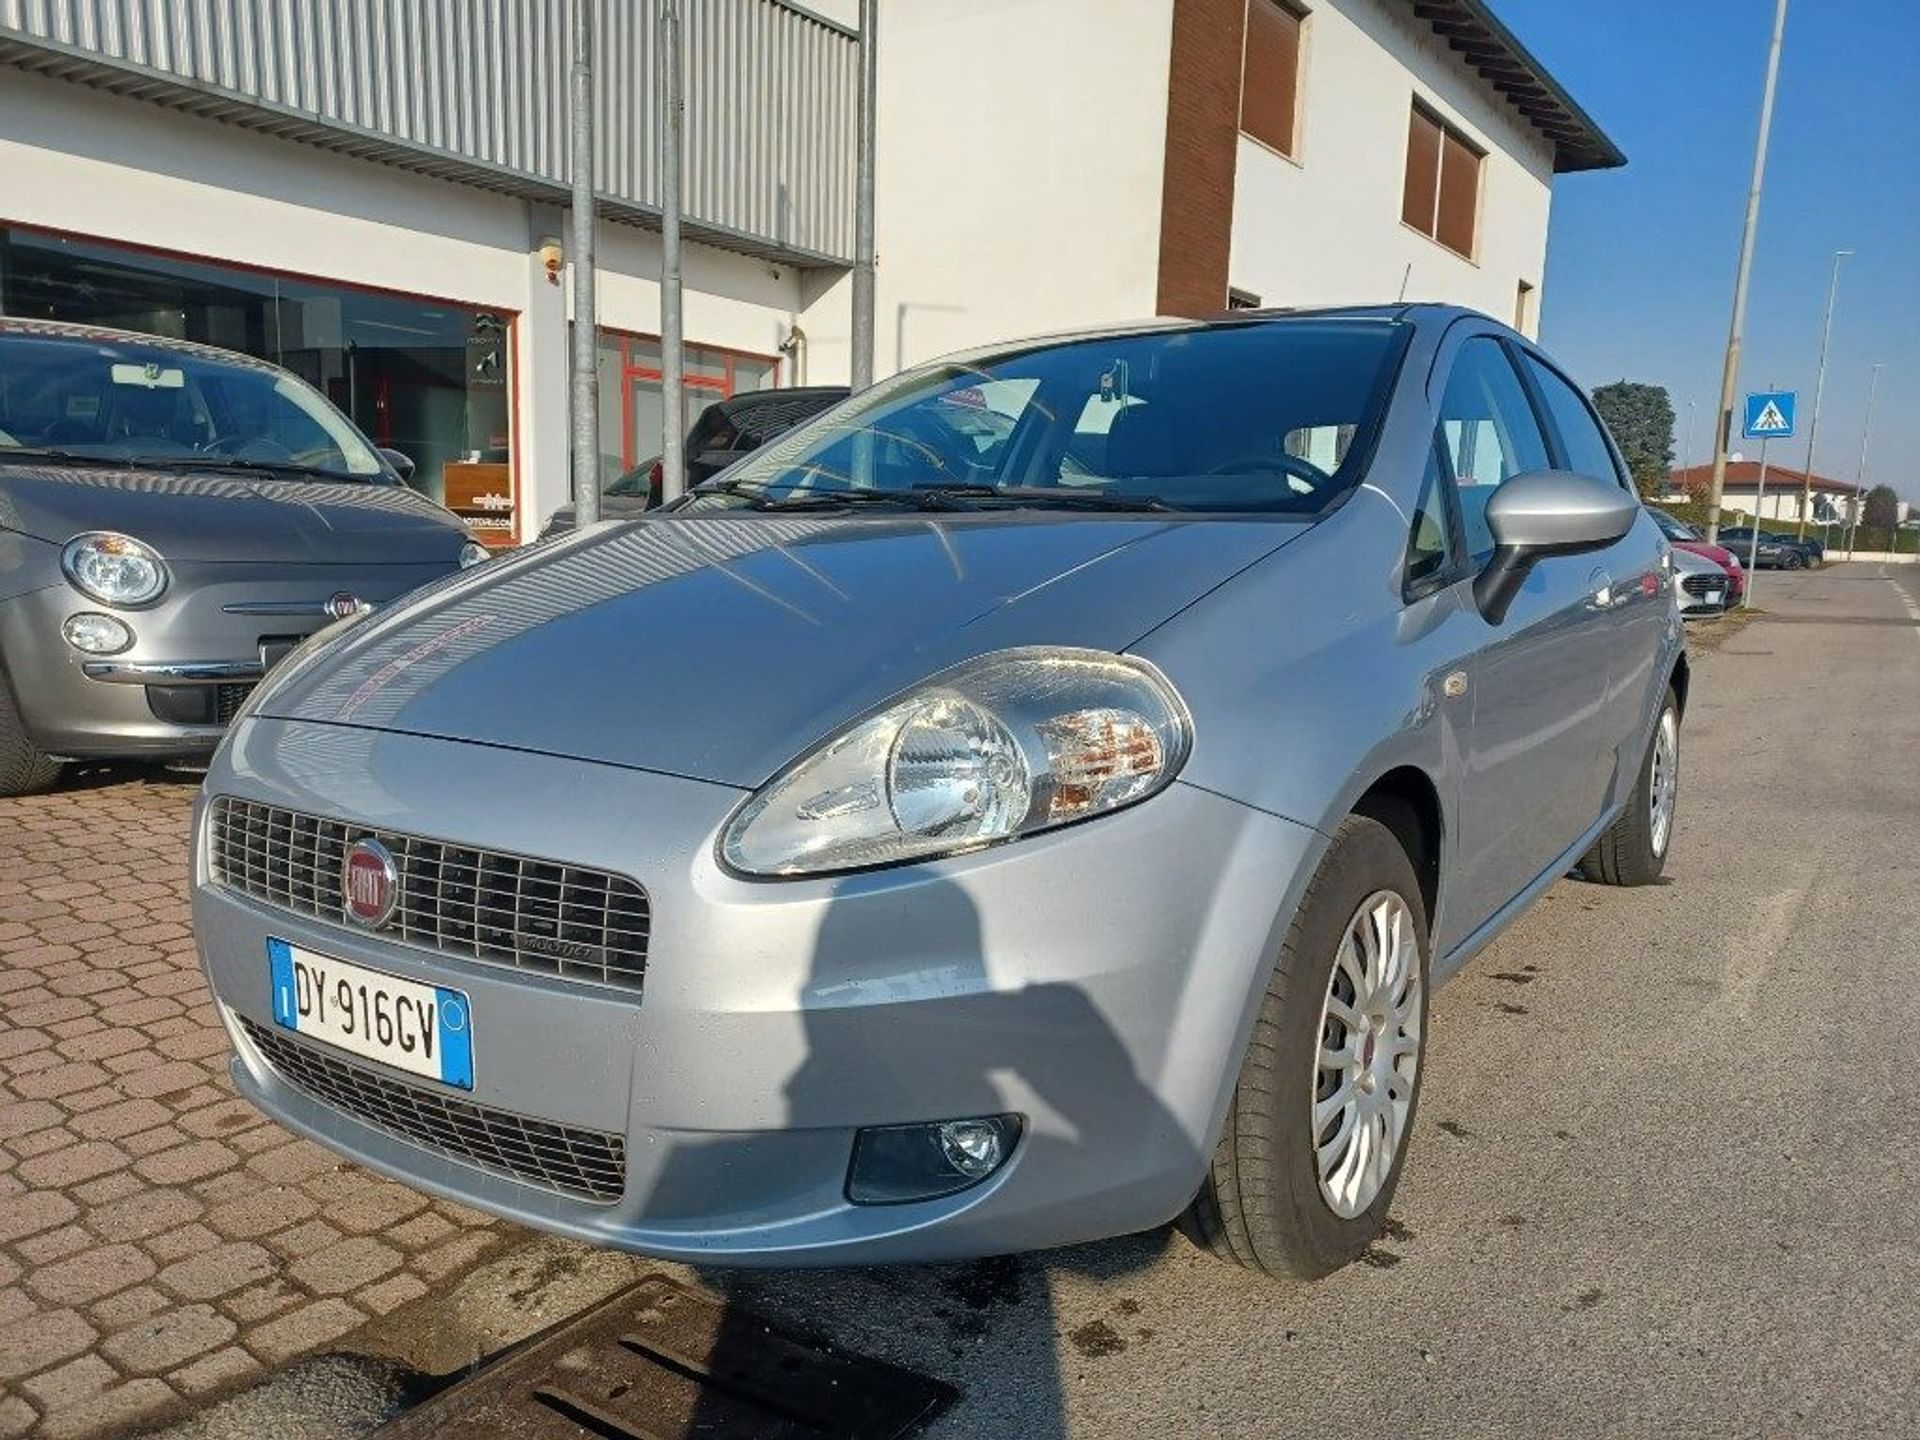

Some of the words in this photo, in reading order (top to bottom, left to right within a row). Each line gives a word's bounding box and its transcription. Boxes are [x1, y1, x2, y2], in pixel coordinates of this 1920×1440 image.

[349, 863, 383, 907] FIAT
[294, 961, 326, 1024] DY
[336, 978, 434, 1059] 916GV
